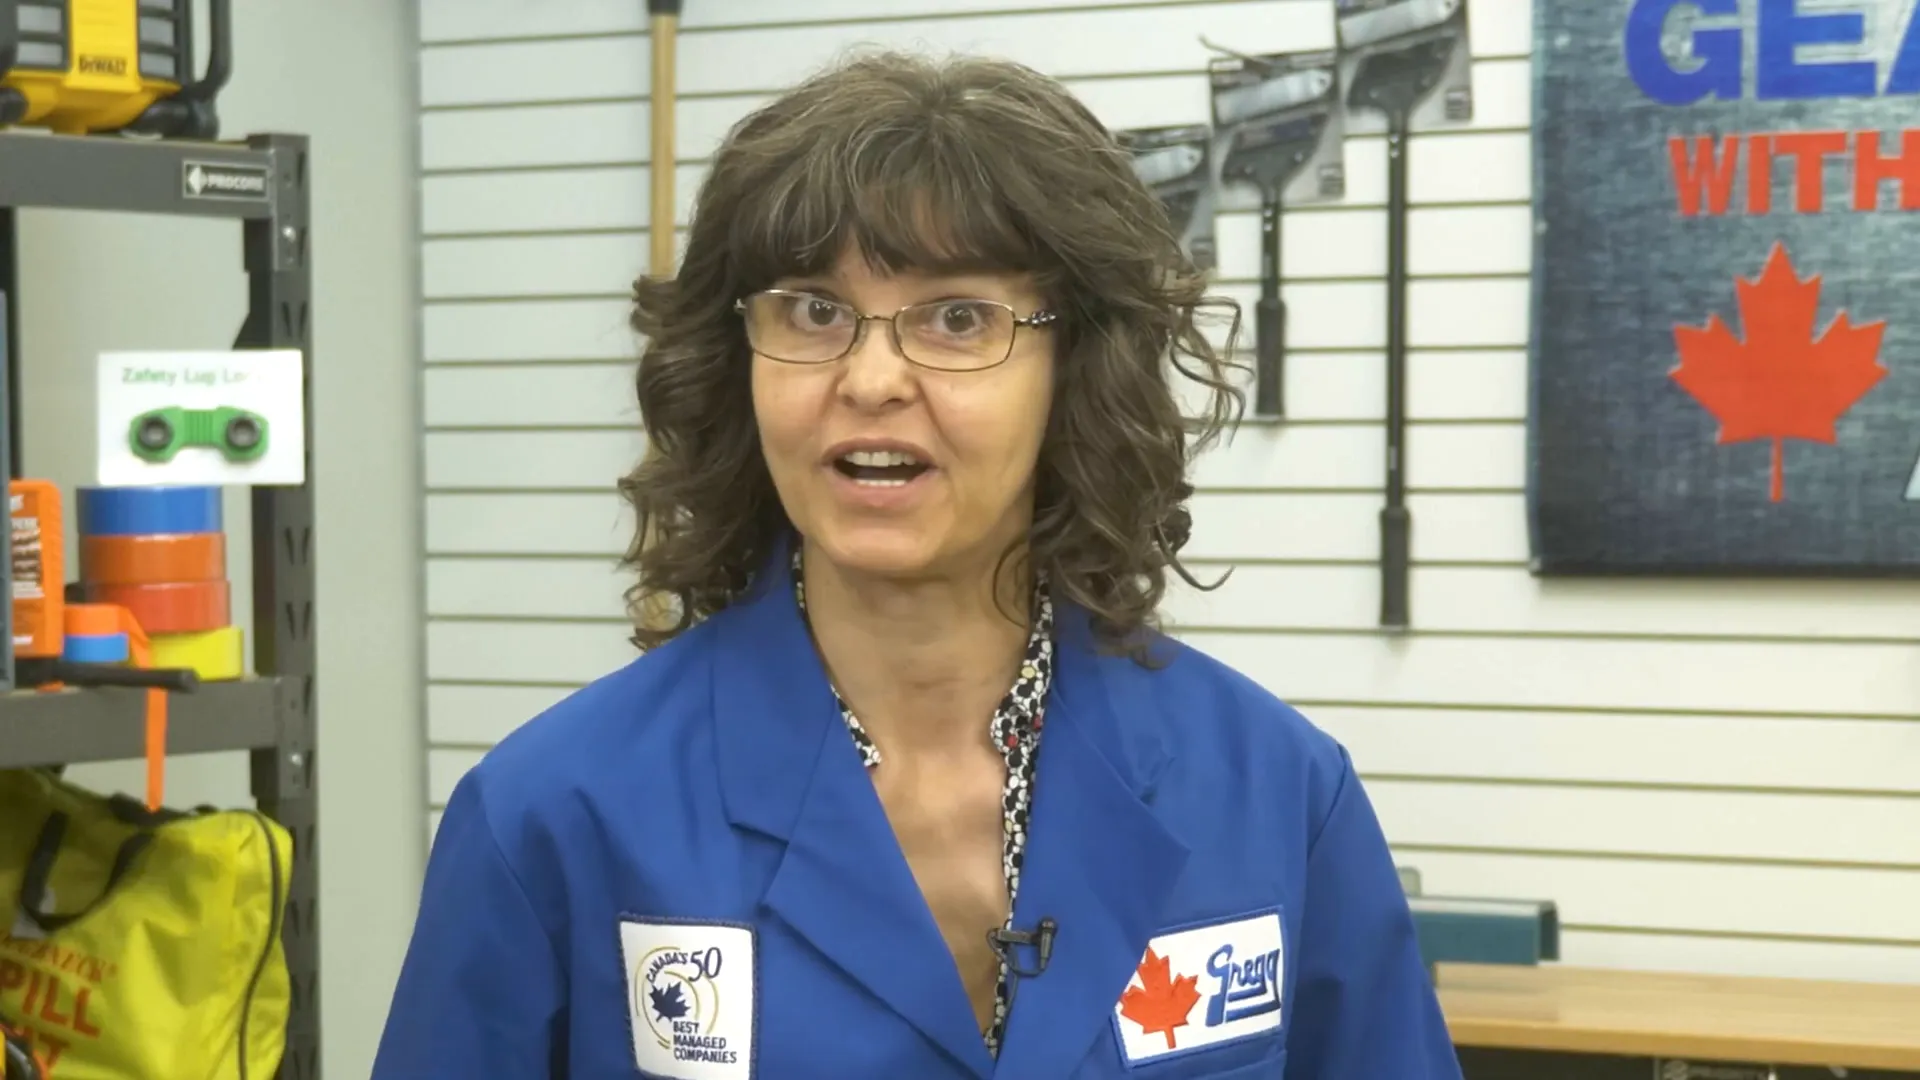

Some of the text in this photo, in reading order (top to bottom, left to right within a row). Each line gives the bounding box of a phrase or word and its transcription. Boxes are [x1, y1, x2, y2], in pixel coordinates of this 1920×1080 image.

[1668, 128, 1920, 216] WITH
[207, 174, 264, 191] PROCORE
[121, 366, 178, 388] Zafety
[183, 366, 217, 388] Lug
[645, 946, 723, 984] CANADA'S 50
[1205, 943, 1281, 1027] Gregg
[673, 1021, 700, 1034] BEST
[673, 1034, 727, 1050] MANAGED
[673, 1047, 738, 1064] COMPANIES
